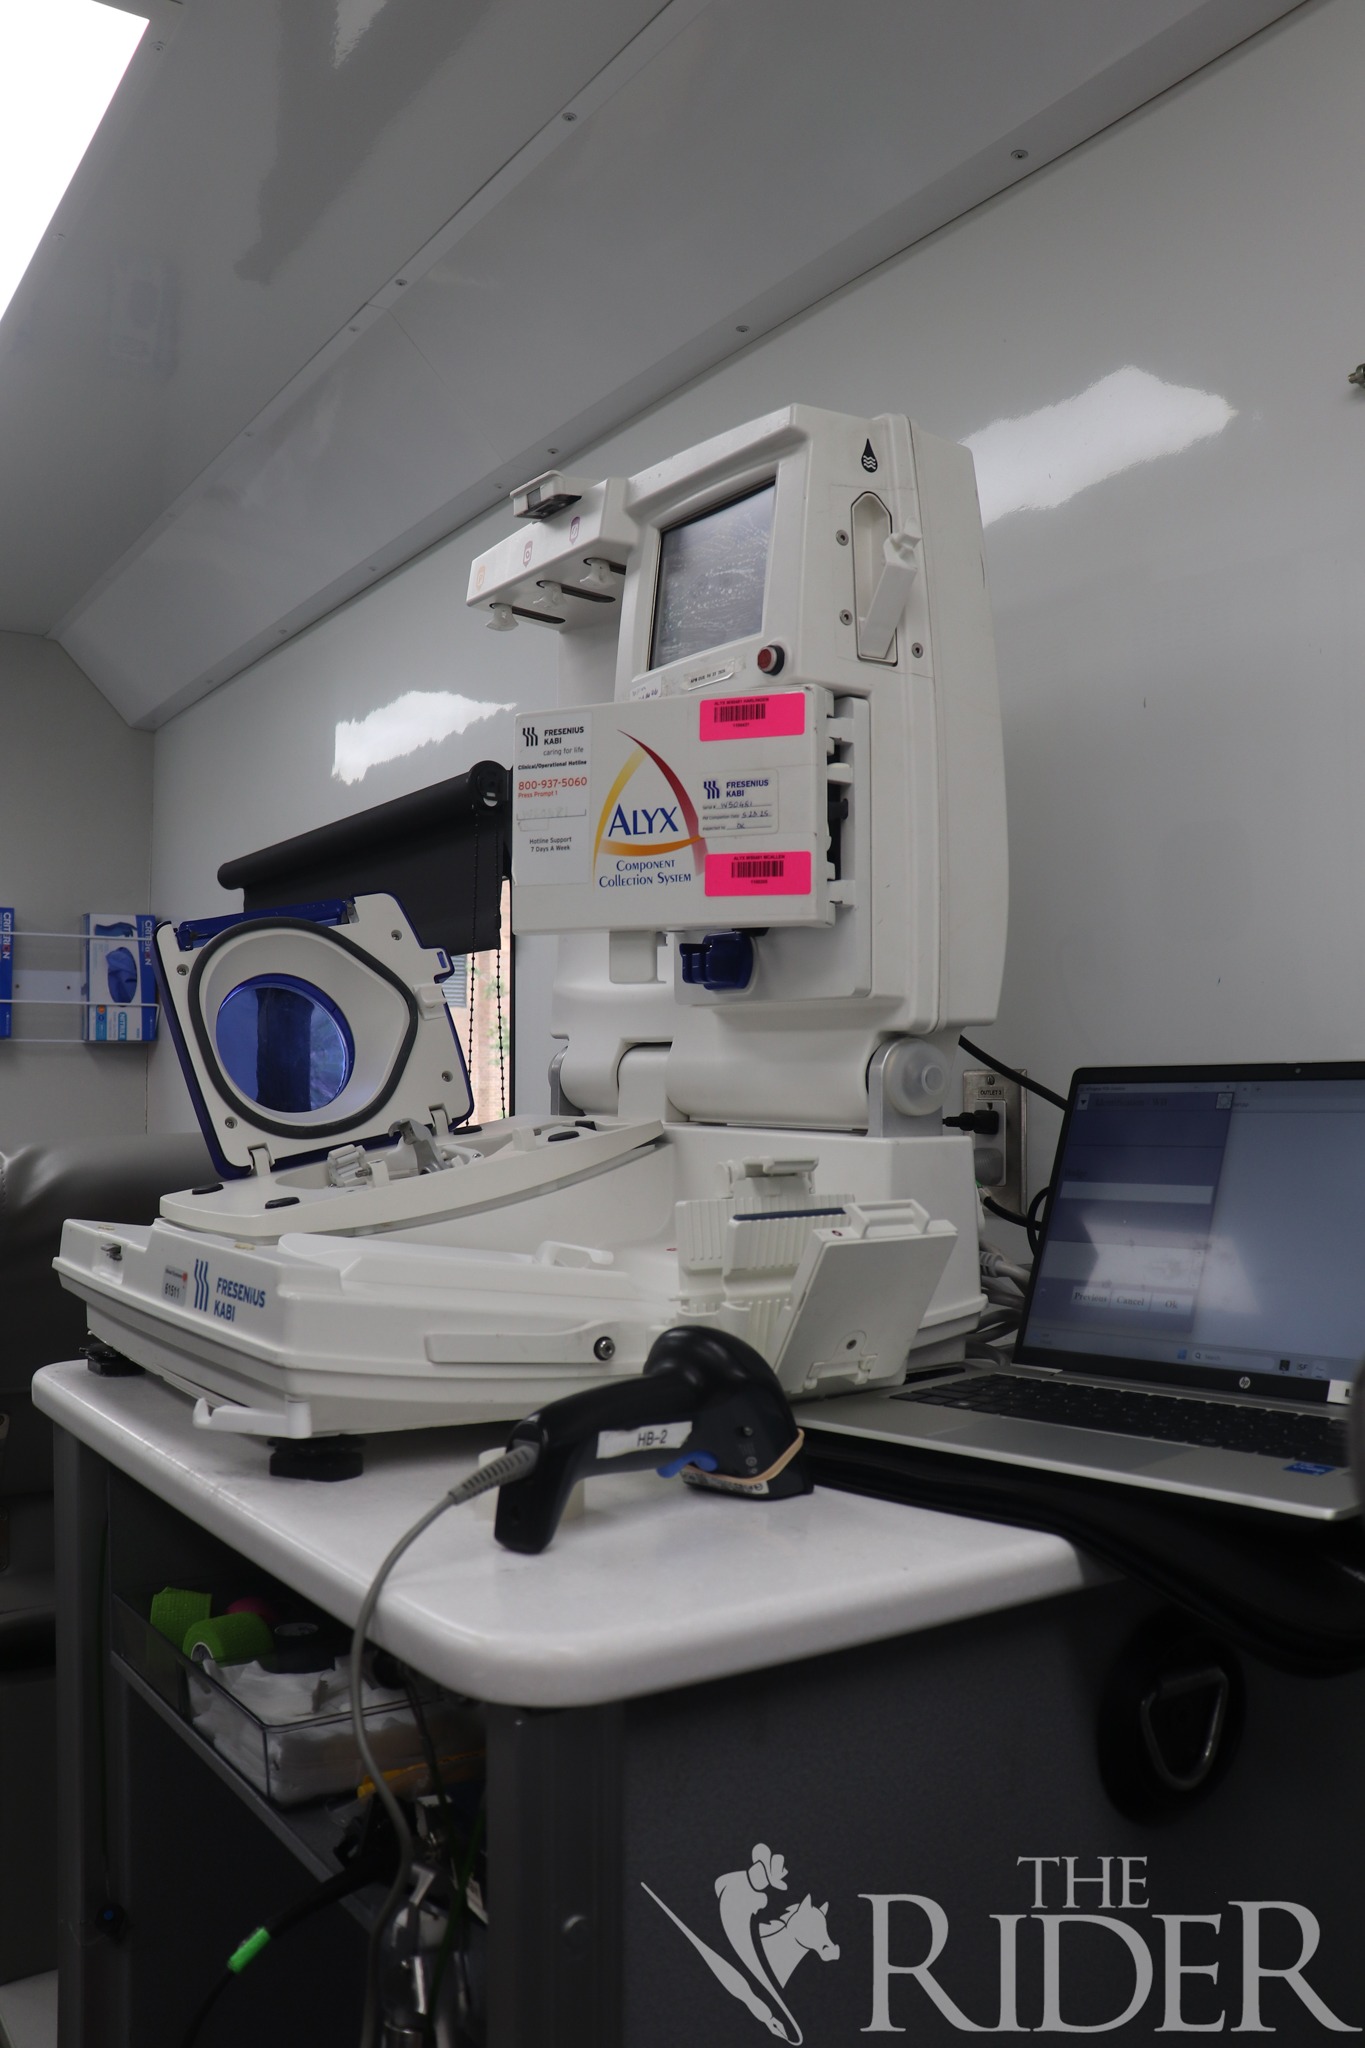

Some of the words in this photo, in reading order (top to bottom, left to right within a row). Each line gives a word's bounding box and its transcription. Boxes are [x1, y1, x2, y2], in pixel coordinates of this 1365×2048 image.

[544, 726, 584, 736] FRESENIUS
[544, 737, 562, 745] KABI
[518, 761, 567, 770] Clinical/Operational
[518, 776, 587, 791] 800-937-5060
[726, 779, 769, 789] FRESENIUS
[726, 789, 744, 798] KABI
[608, 803, 679, 837] ALYX
[550, 836, 572, 844] Support
[216, 1277, 266, 1309] FRESENIUS
[1073, 1291, 1107, 1303] Previous
[1116, 1295, 1145, 1307] Cancel
[1164, 1300, 1178, 1310] Ok
[213, 1299, 236, 1322] KABI
[1239, 1376, 1251, 1389] hp
[637, 1429, 668, 1447] HB-2
